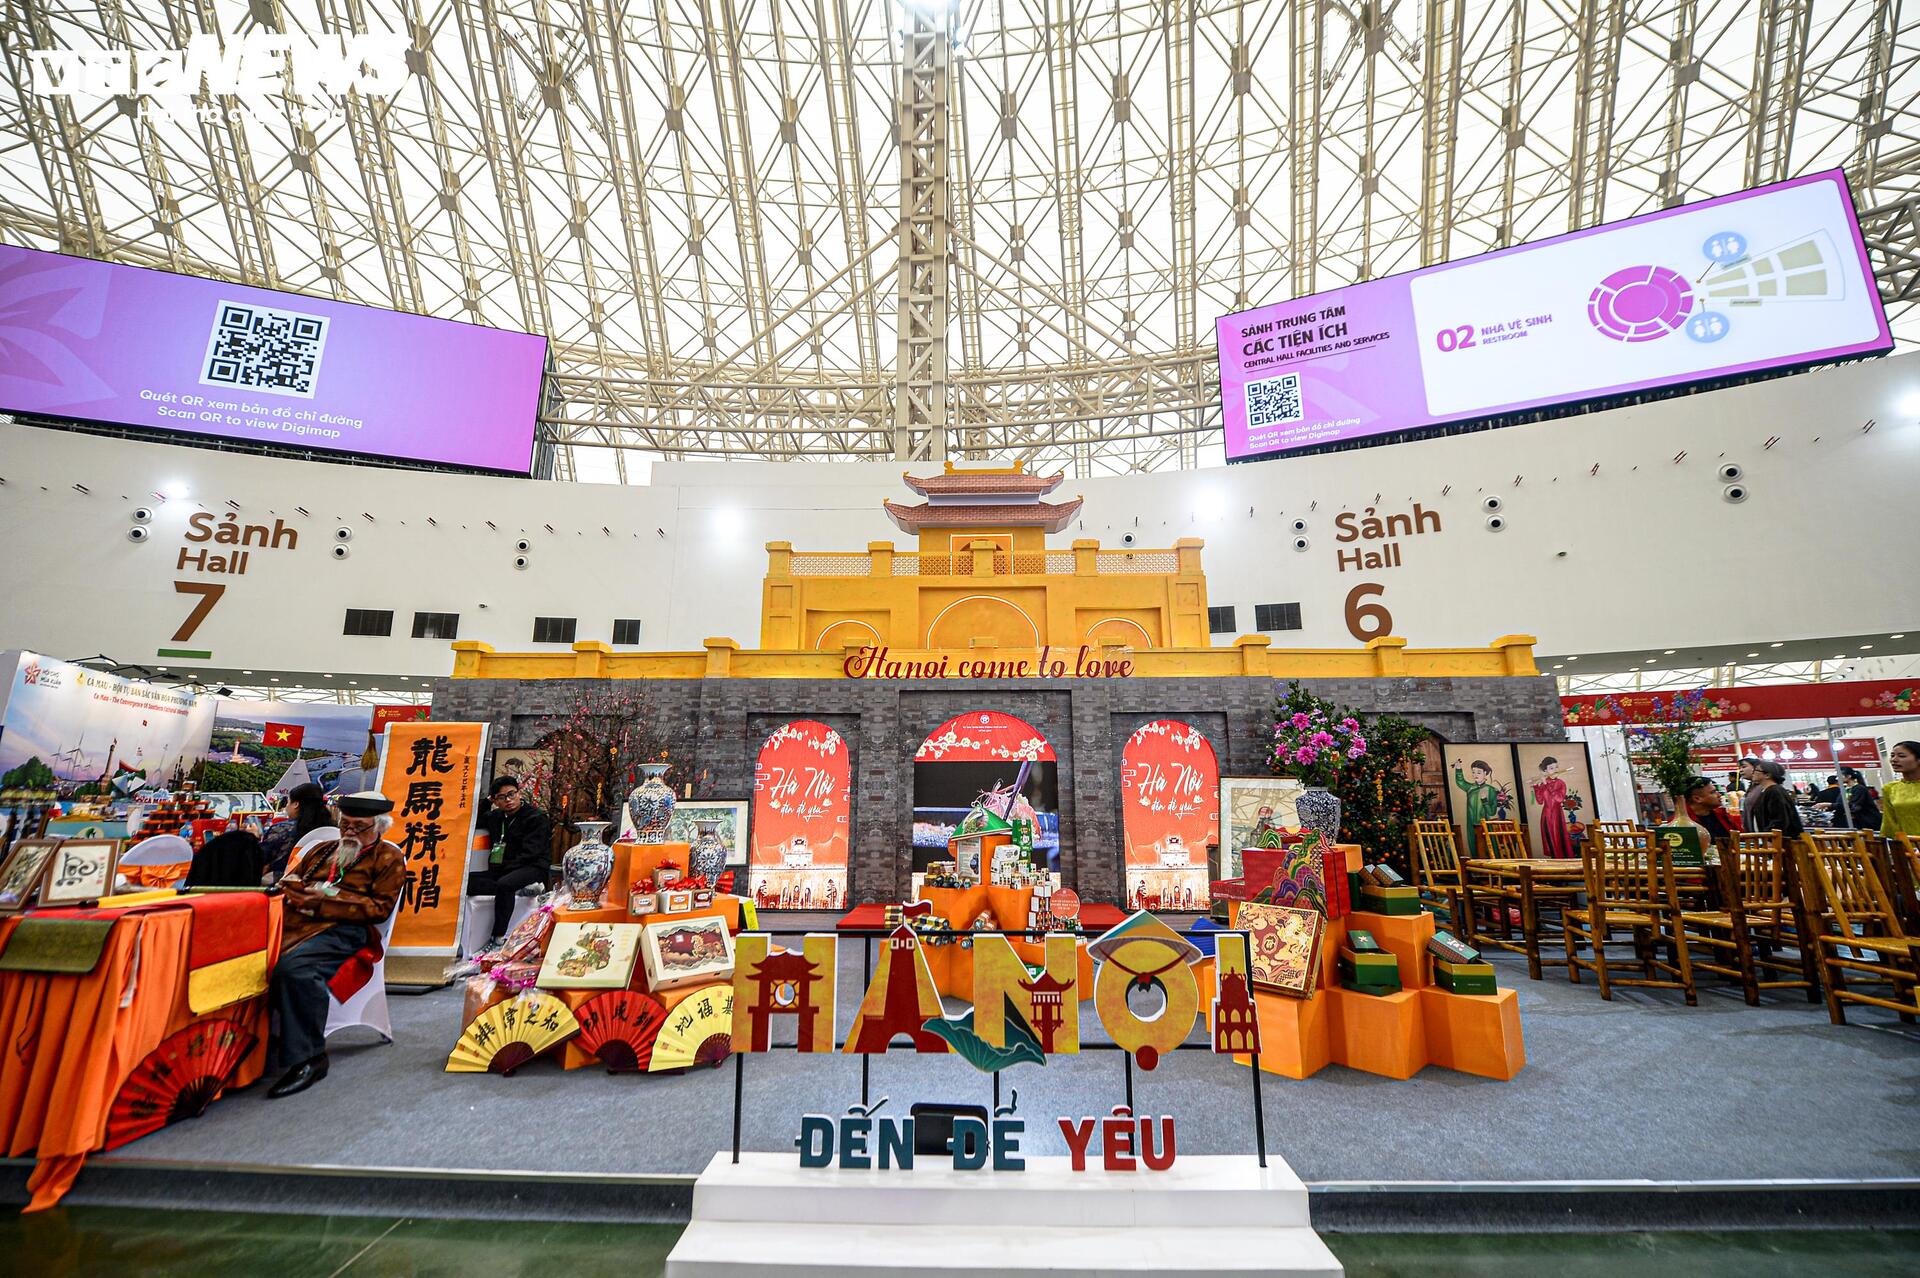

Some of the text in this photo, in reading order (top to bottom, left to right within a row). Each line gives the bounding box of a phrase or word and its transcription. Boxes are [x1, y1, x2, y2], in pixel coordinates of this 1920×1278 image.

[1241, 306, 1346, 338] SẢNH TRUNG TÂM
[1483, 330, 1528, 344] RESTROOM
[1525, 314, 1553, 327] SINH
[1243, 322, 1348, 356] CÁC TIỆN ÍCH
[1244, 331, 1390, 368] CENTRAL HALL FACILITIES AND SERVICES
[1437, 325, 1476, 352] 02
[140, 389, 177, 403] Quét
[181, 394, 203, 406] QR
[207, 400, 238, 411] xem
[241, 403, 268, 415] bản
[295, 410, 317, 421] chỉ
[319, 413, 362, 429] đường
[157, 406, 340, 439] Scan QR to view Digimap
[1249, 441, 1268, 449] Scan
[1281, 436, 1289, 444] to
[1291, 433, 1308, 442] view
[1309, 429, 1340, 439] Digimap
[1268, 431, 1278, 439] QR
[1280, 429, 1295, 437] xem
[184, 512, 298, 549] Sảnh
[1335, 503, 1441, 542] Sảnh
[177, 547, 249, 575] Hall
[1337, 543, 1401, 572] Hall
[171, 581, 226, 642] 7
[1344, 583, 1393, 642] 6
[843, 645, 1134, 679] Hanoi come to love
[770, 767, 836, 799] Hà Nội
[1137, 762, 1204, 797] Hà Nội
[794, 1088, 1177, 1171] ĐẾN ĐỂ YÊU
